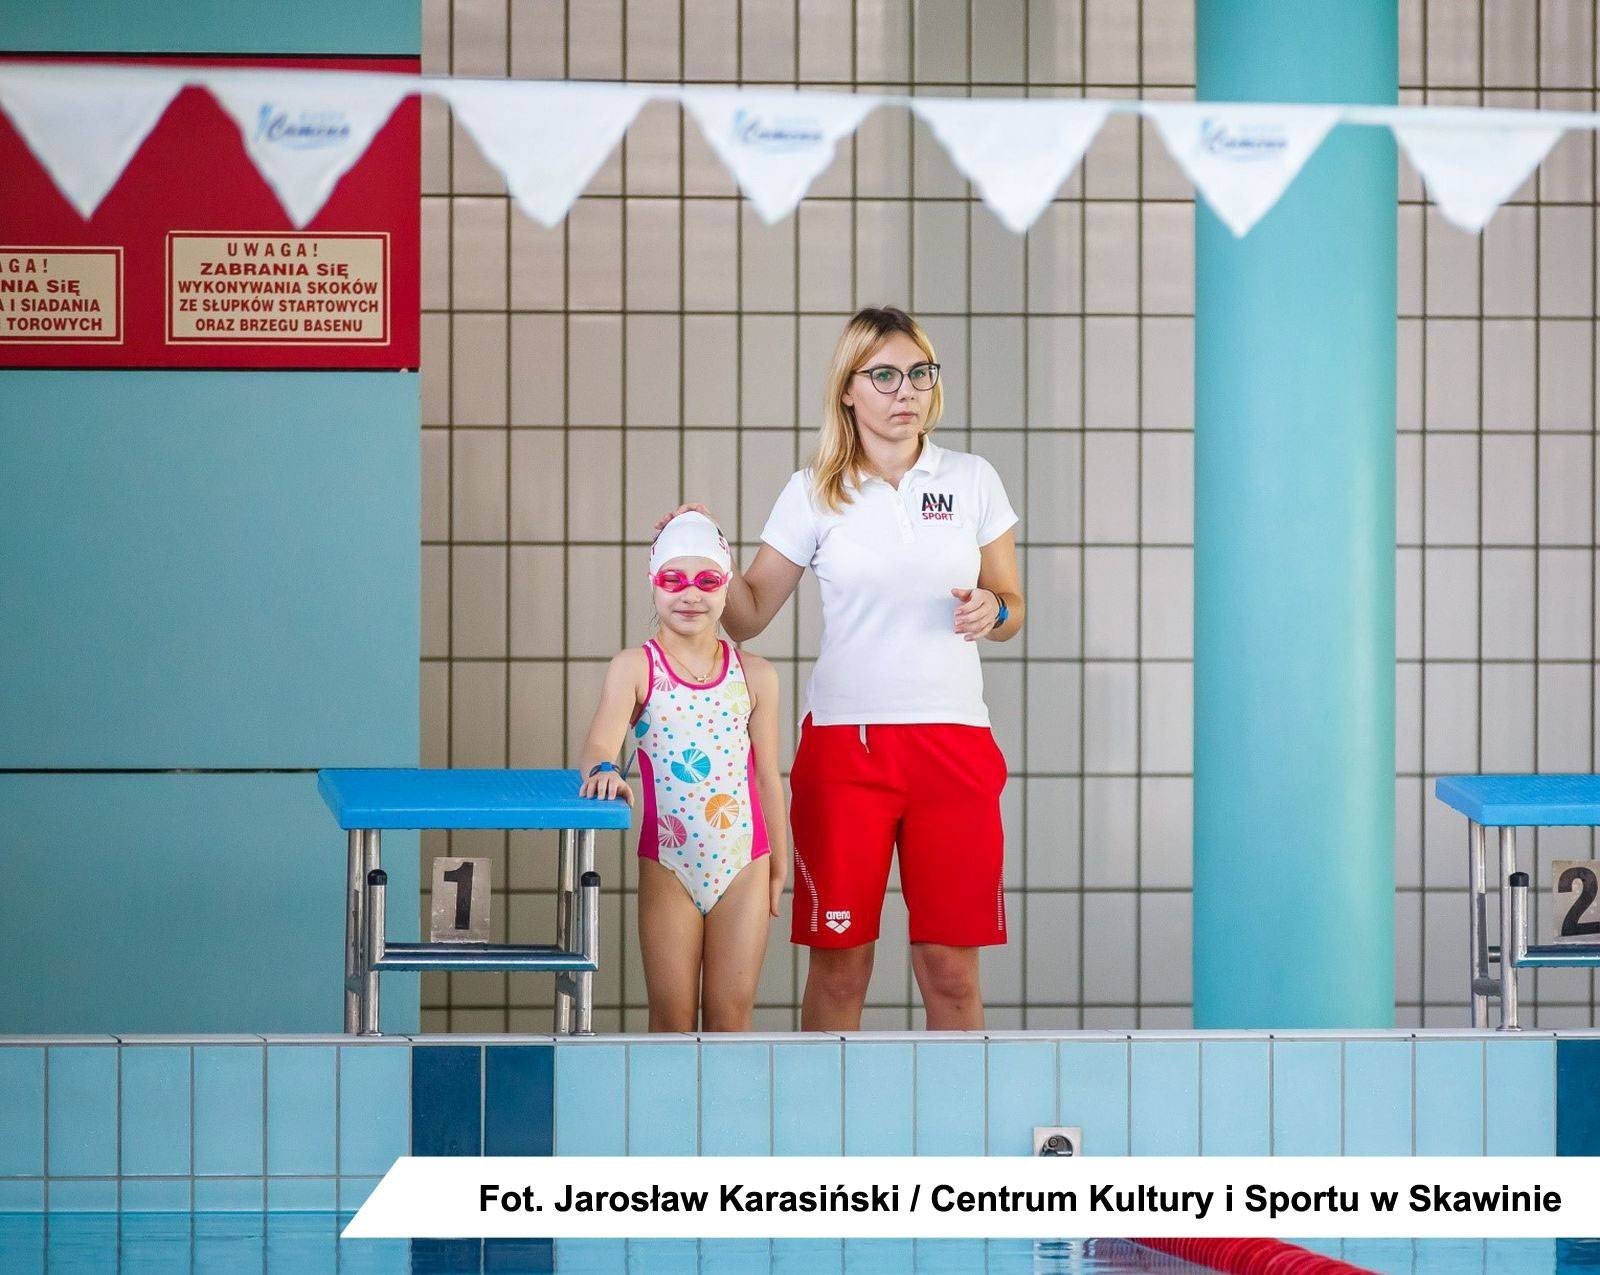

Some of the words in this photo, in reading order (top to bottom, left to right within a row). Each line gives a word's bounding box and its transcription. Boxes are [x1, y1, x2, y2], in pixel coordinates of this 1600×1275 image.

[0, 258, 48, 273] GA!
[200, 262, 309, 276] ZABRANIA
[178, 280, 302, 294] WYKONYWANIA
[307, 278, 378, 295] SKOKÓW
[10, 299, 15, 312] I
[21, 298, 101, 312] SIADANIA
[179, 298, 198, 312] ZE
[202, 296, 274, 312] SŁUPKÓW
[279, 299, 378, 313] STARTOWYCH
[6, 318, 103, 331] TOROWYCH
[195, 318, 235, 332] ORAZ
[240, 318, 298, 332] BRZEGU
[303, 319, 363, 332] BASENU
[922, 512, 954, 521] SPORT
[443, 861, 474, 930] 1
[1558, 867, 1600, 937] 2
